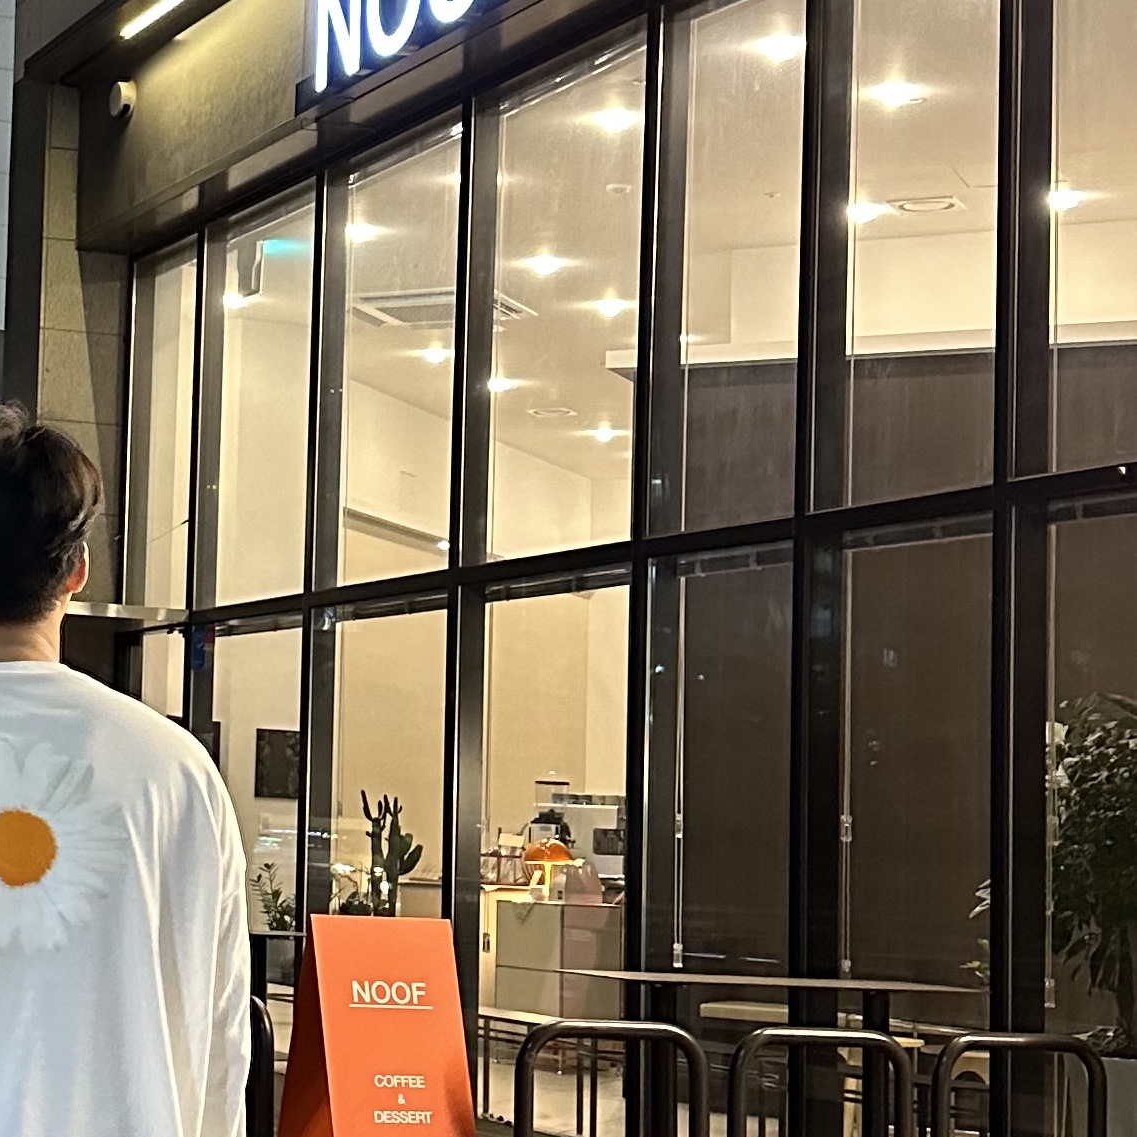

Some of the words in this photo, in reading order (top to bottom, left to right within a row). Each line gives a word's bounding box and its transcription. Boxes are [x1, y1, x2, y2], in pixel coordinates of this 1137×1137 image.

[314, 0, 474, 93] NO
[351, 980, 426, 1005] NOOF
[373, 1074, 426, 1089] COFFEE
[397, 1093, 406, 1105] &
[373, 1110, 433, 1124] DESSERT
